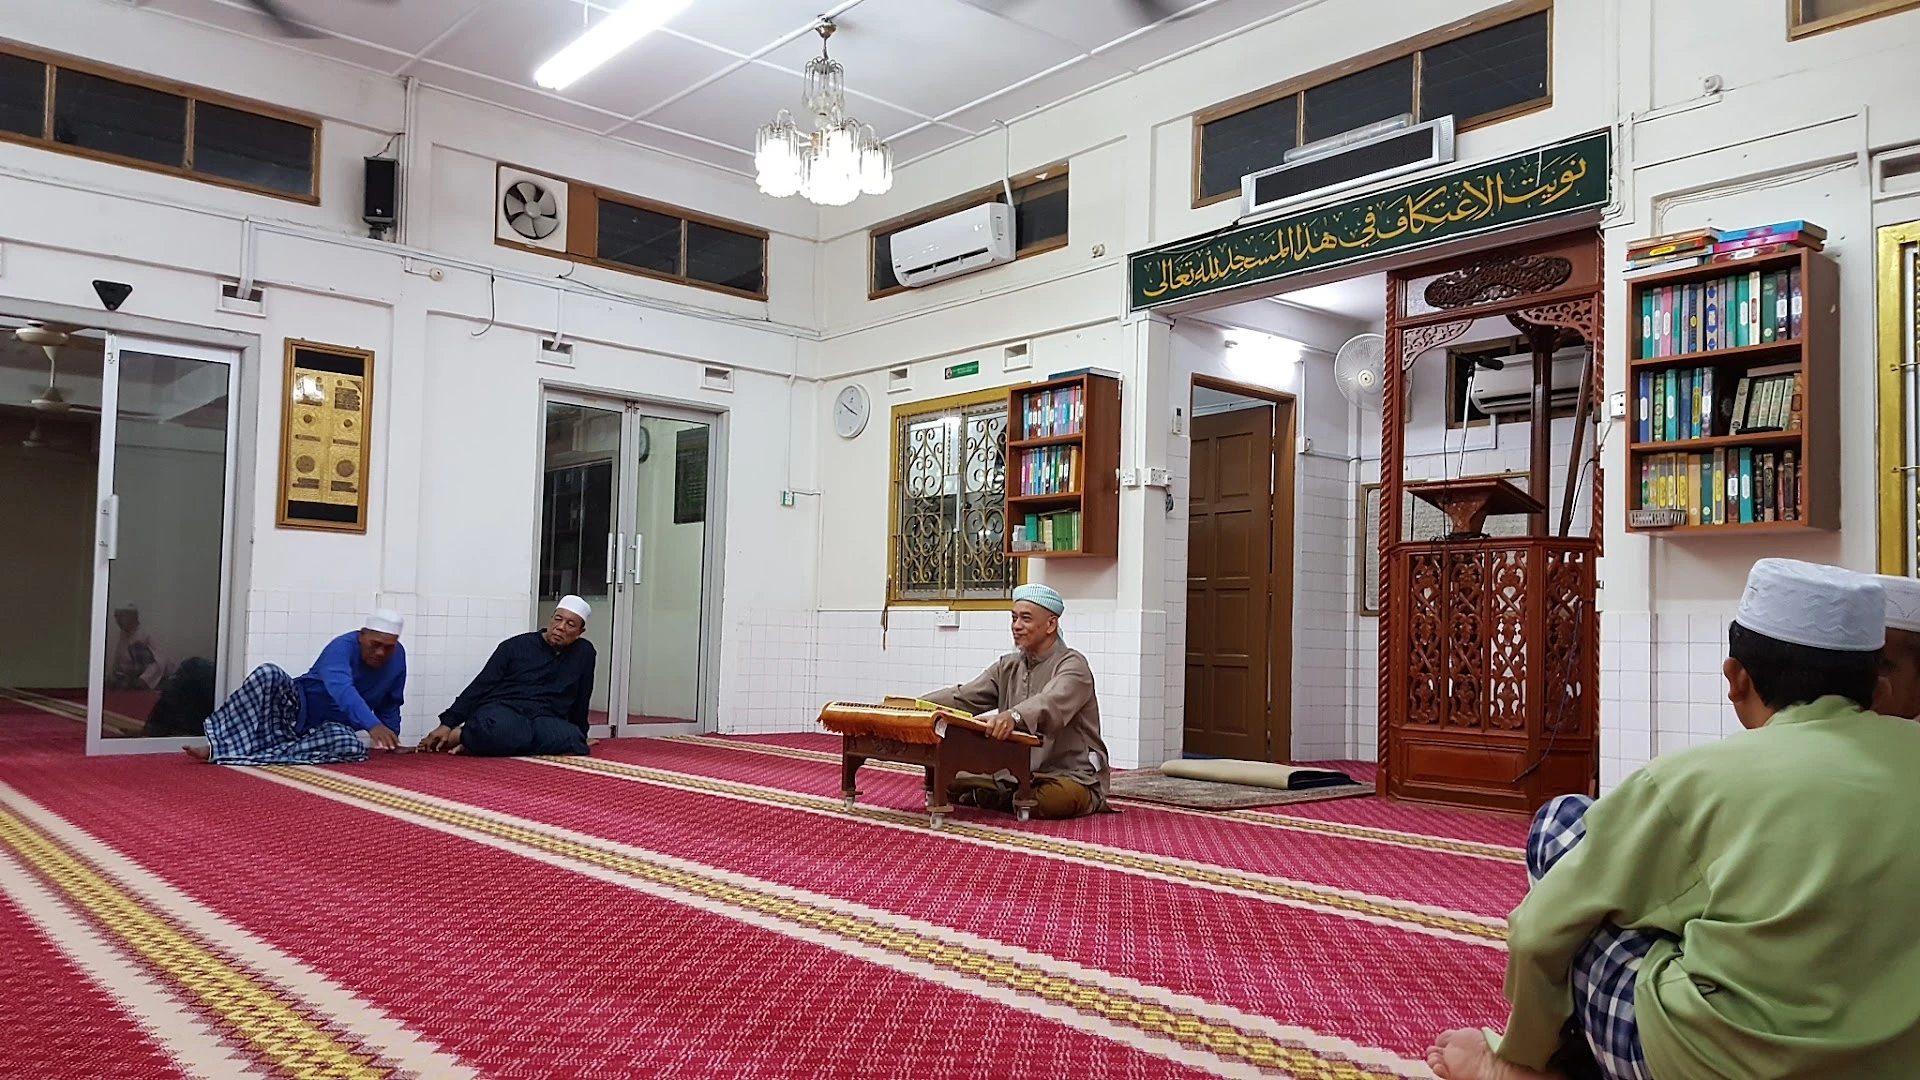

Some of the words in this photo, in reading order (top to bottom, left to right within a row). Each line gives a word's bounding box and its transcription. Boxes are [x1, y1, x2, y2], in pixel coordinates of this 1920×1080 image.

[1338, 205, 1377, 249] في
[1376, 171, 1504, 239] الاعتكاف
[1218, 225, 1294, 278] المسجد
[1293, 217, 1338, 261] هذا
[1194, 250, 1222, 287] لله
